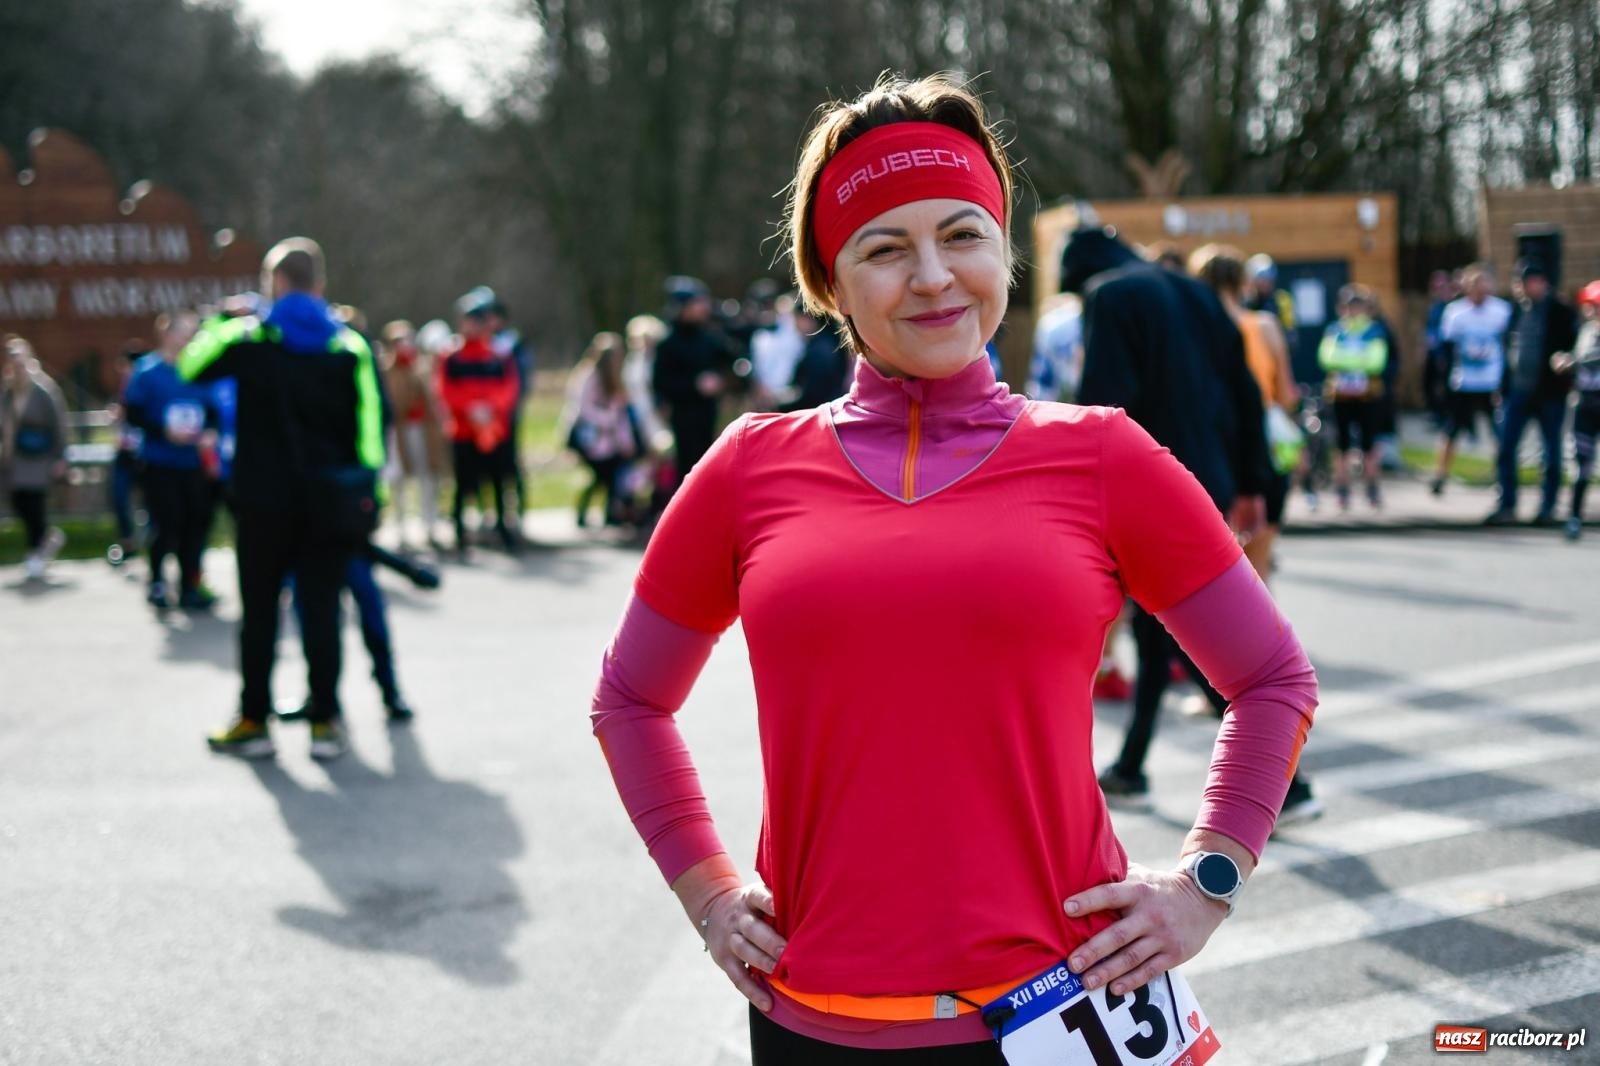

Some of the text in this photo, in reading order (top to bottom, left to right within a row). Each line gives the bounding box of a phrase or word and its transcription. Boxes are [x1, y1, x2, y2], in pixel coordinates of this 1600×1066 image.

[837, 149, 971, 205] BRUBECK
[1008, 966, 1069, 1009] XII BIEG
[1060, 982, 1074, 996] 25
[1059, 980, 1169, 1066] 13
